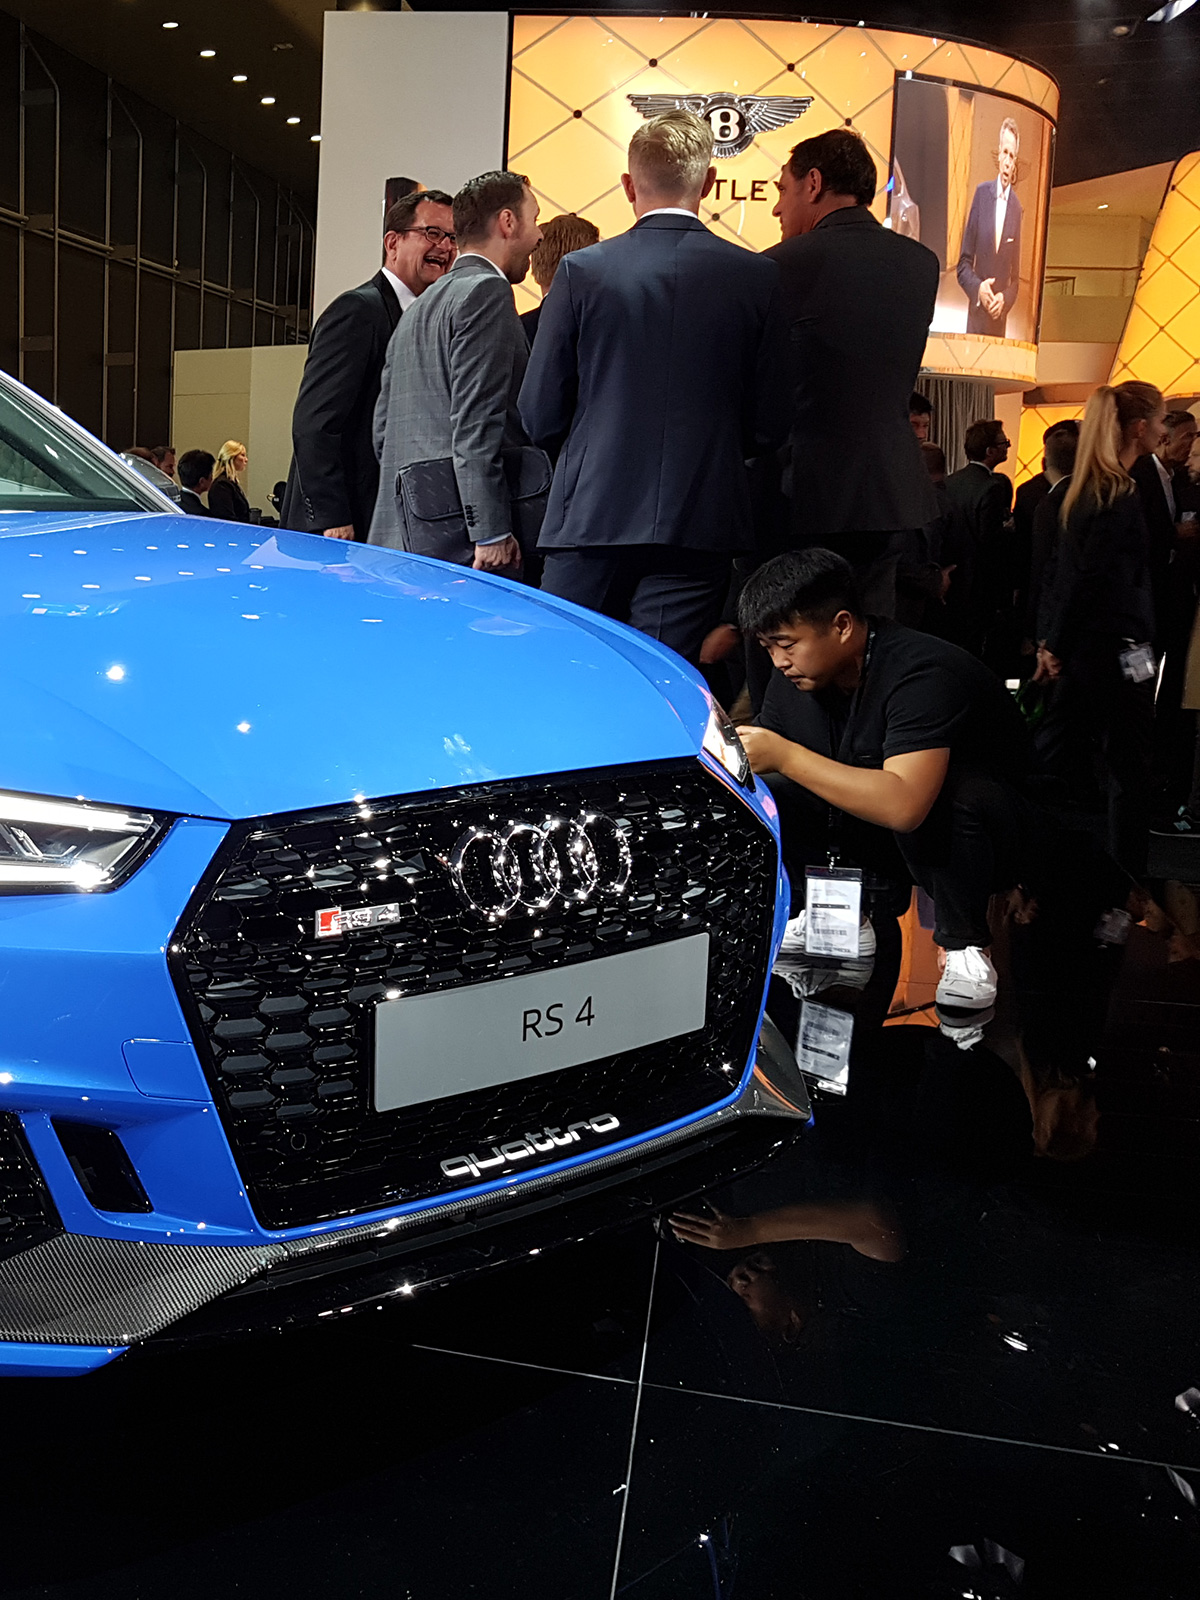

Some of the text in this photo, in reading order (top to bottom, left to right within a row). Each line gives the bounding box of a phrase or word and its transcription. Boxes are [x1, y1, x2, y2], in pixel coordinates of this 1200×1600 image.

[709, 108, 740, 142] B
[522, 996, 595, 1042] RS 4
[439, 1113, 620, 1177] quattro
